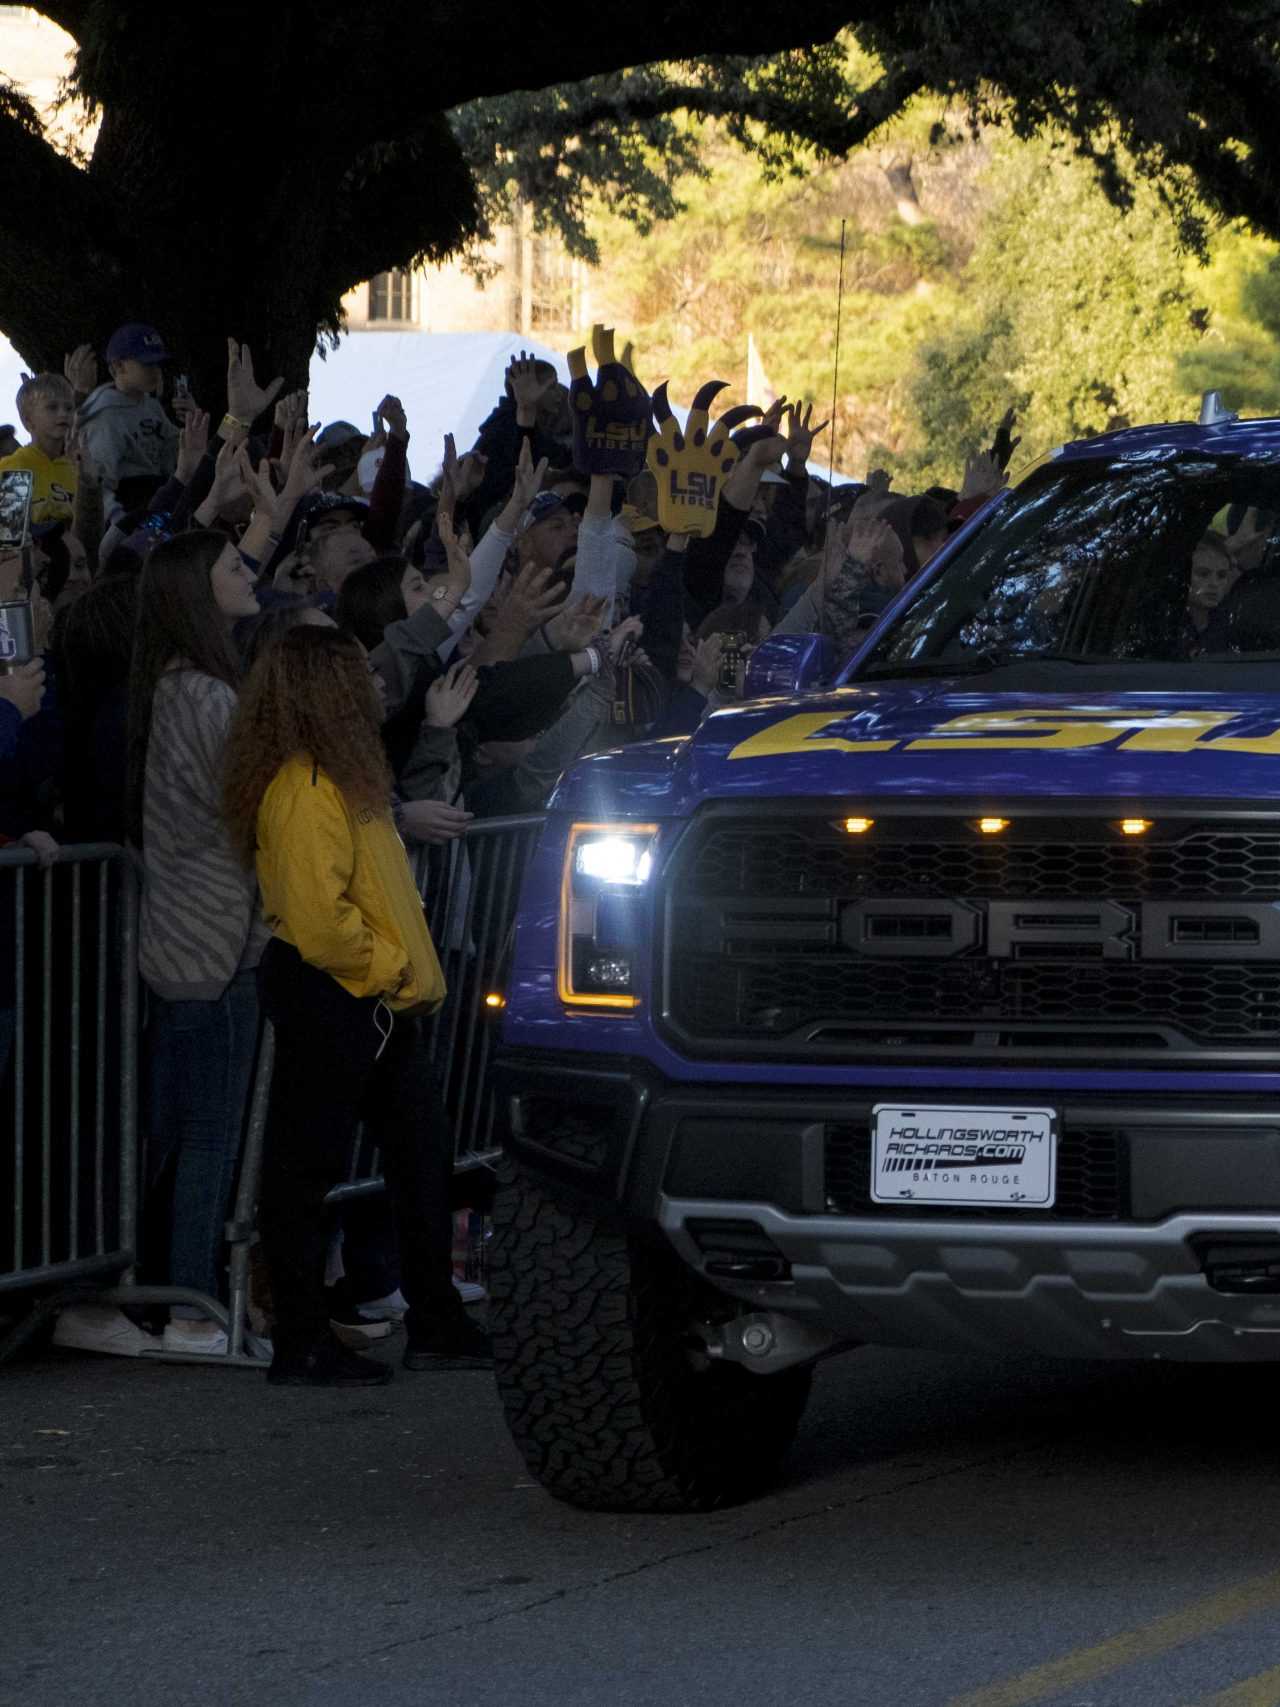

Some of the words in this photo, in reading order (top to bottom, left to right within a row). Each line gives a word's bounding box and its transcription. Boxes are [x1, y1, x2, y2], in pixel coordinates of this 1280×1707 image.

[586, 415, 647, 441] LSU
[670, 469, 717, 499] LSU
[889, 1127, 1044, 1143] HOLLINGSWORTH
[912, 1172, 961, 1183] BATON
[970, 1174, 1021, 1185] ROUGE
